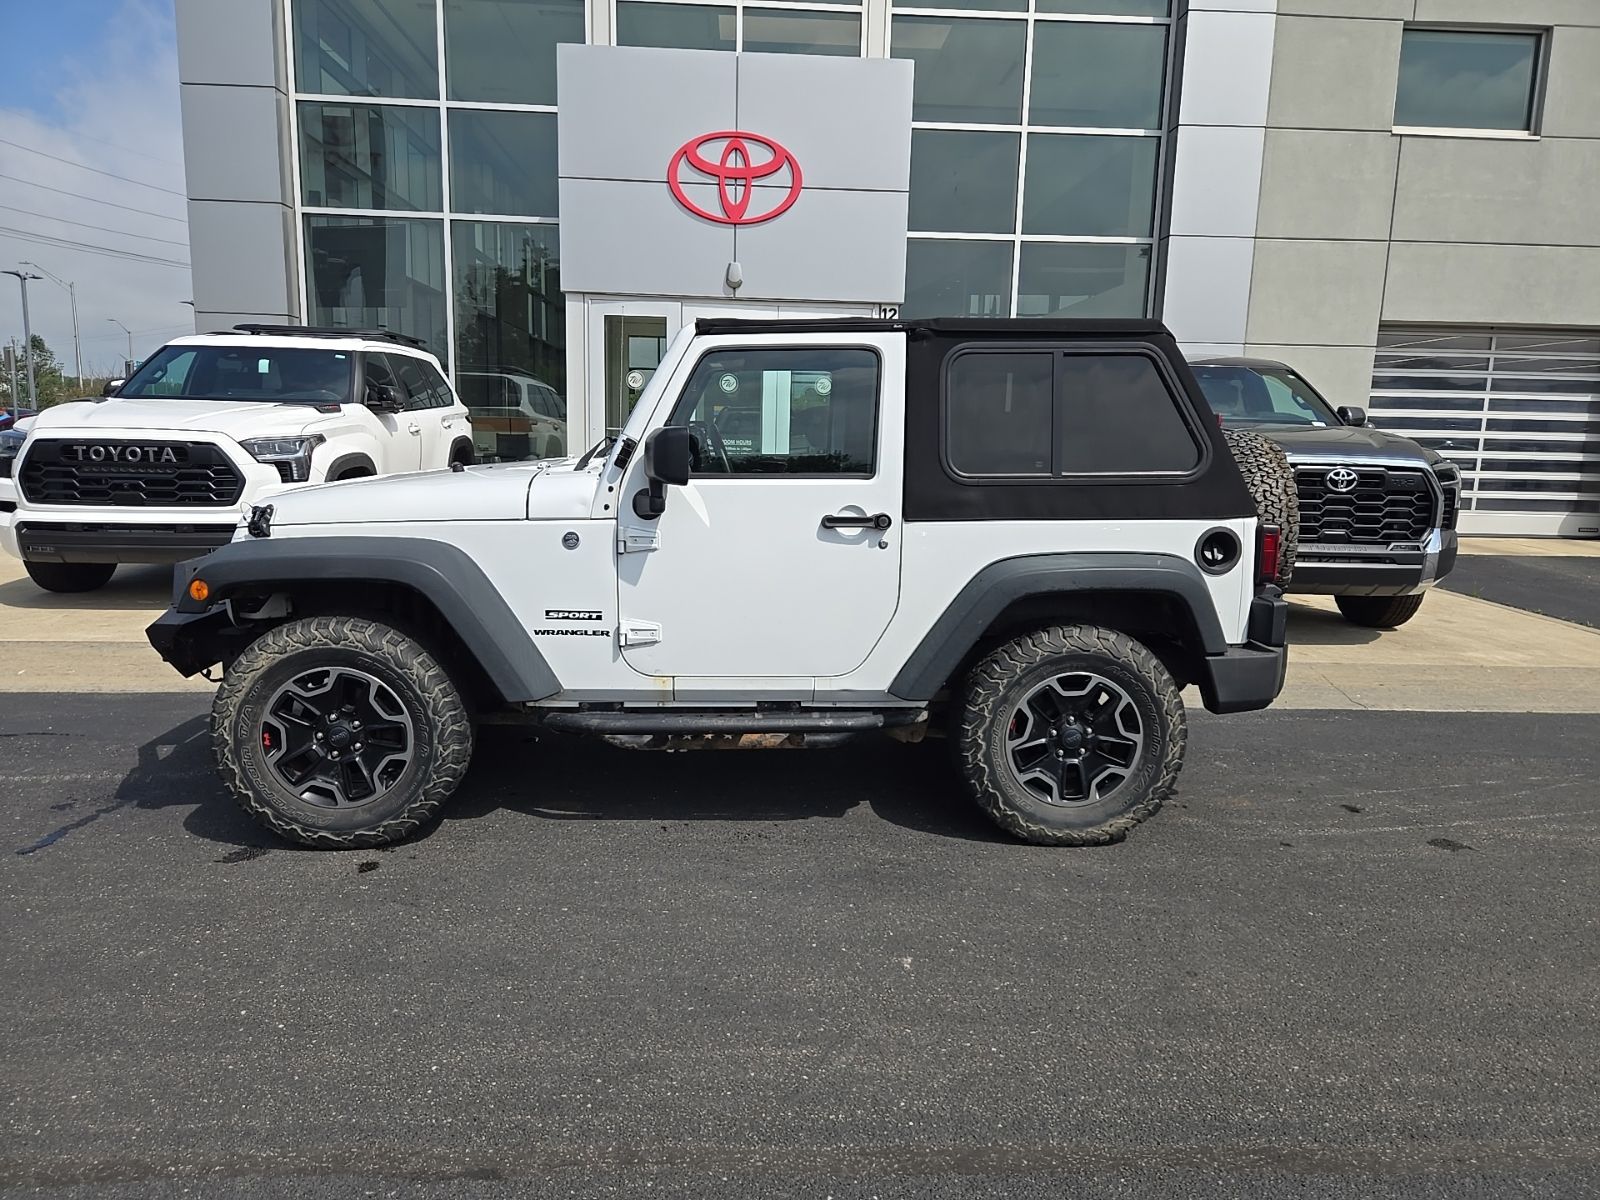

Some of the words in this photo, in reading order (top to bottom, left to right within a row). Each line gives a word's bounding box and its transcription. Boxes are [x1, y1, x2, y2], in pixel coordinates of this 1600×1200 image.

[881, 307, 898, 320] 12
[73, 446, 177, 463] TOYOTA
[547, 611, 603, 620] SPORT
[533, 629, 611, 638] WRANGLER
